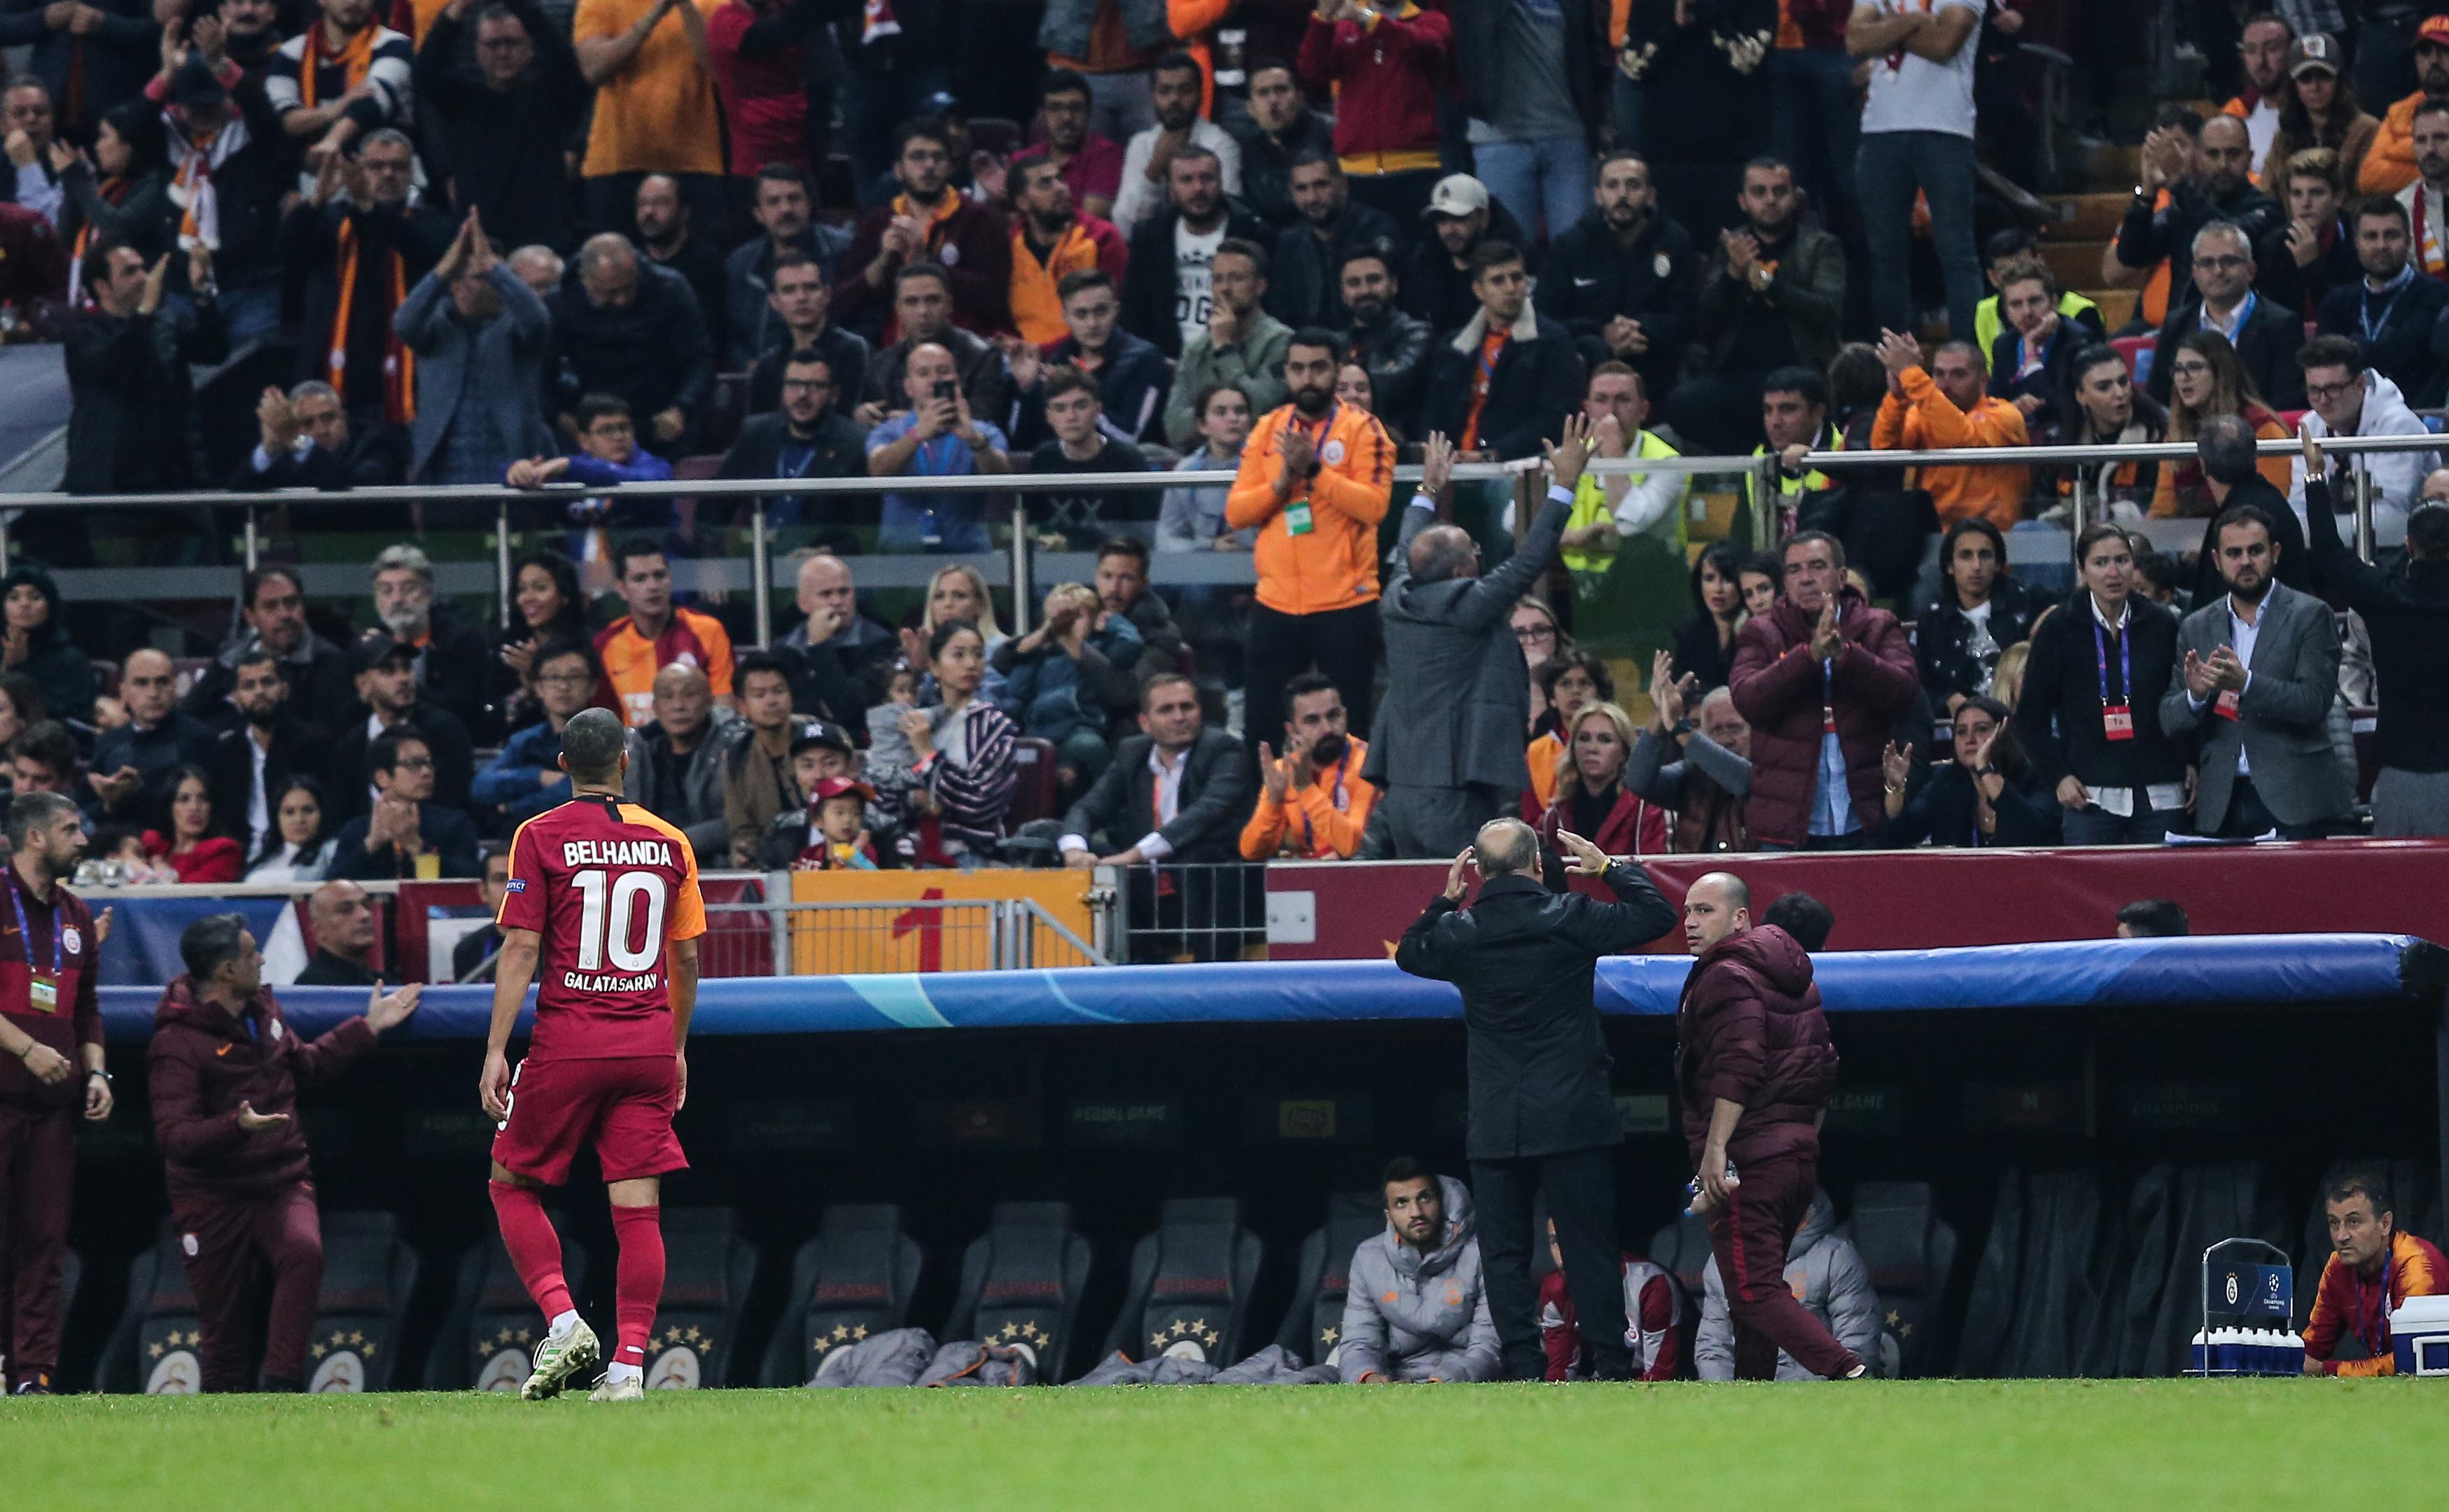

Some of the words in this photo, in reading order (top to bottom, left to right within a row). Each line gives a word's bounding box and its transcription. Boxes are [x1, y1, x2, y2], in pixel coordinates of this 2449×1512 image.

[564, 841, 673, 867] BELHANDA
[571, 869, 667, 972] 10
[892, 887, 944, 972] 1
[564, 972, 657, 992] GALATASARAY
